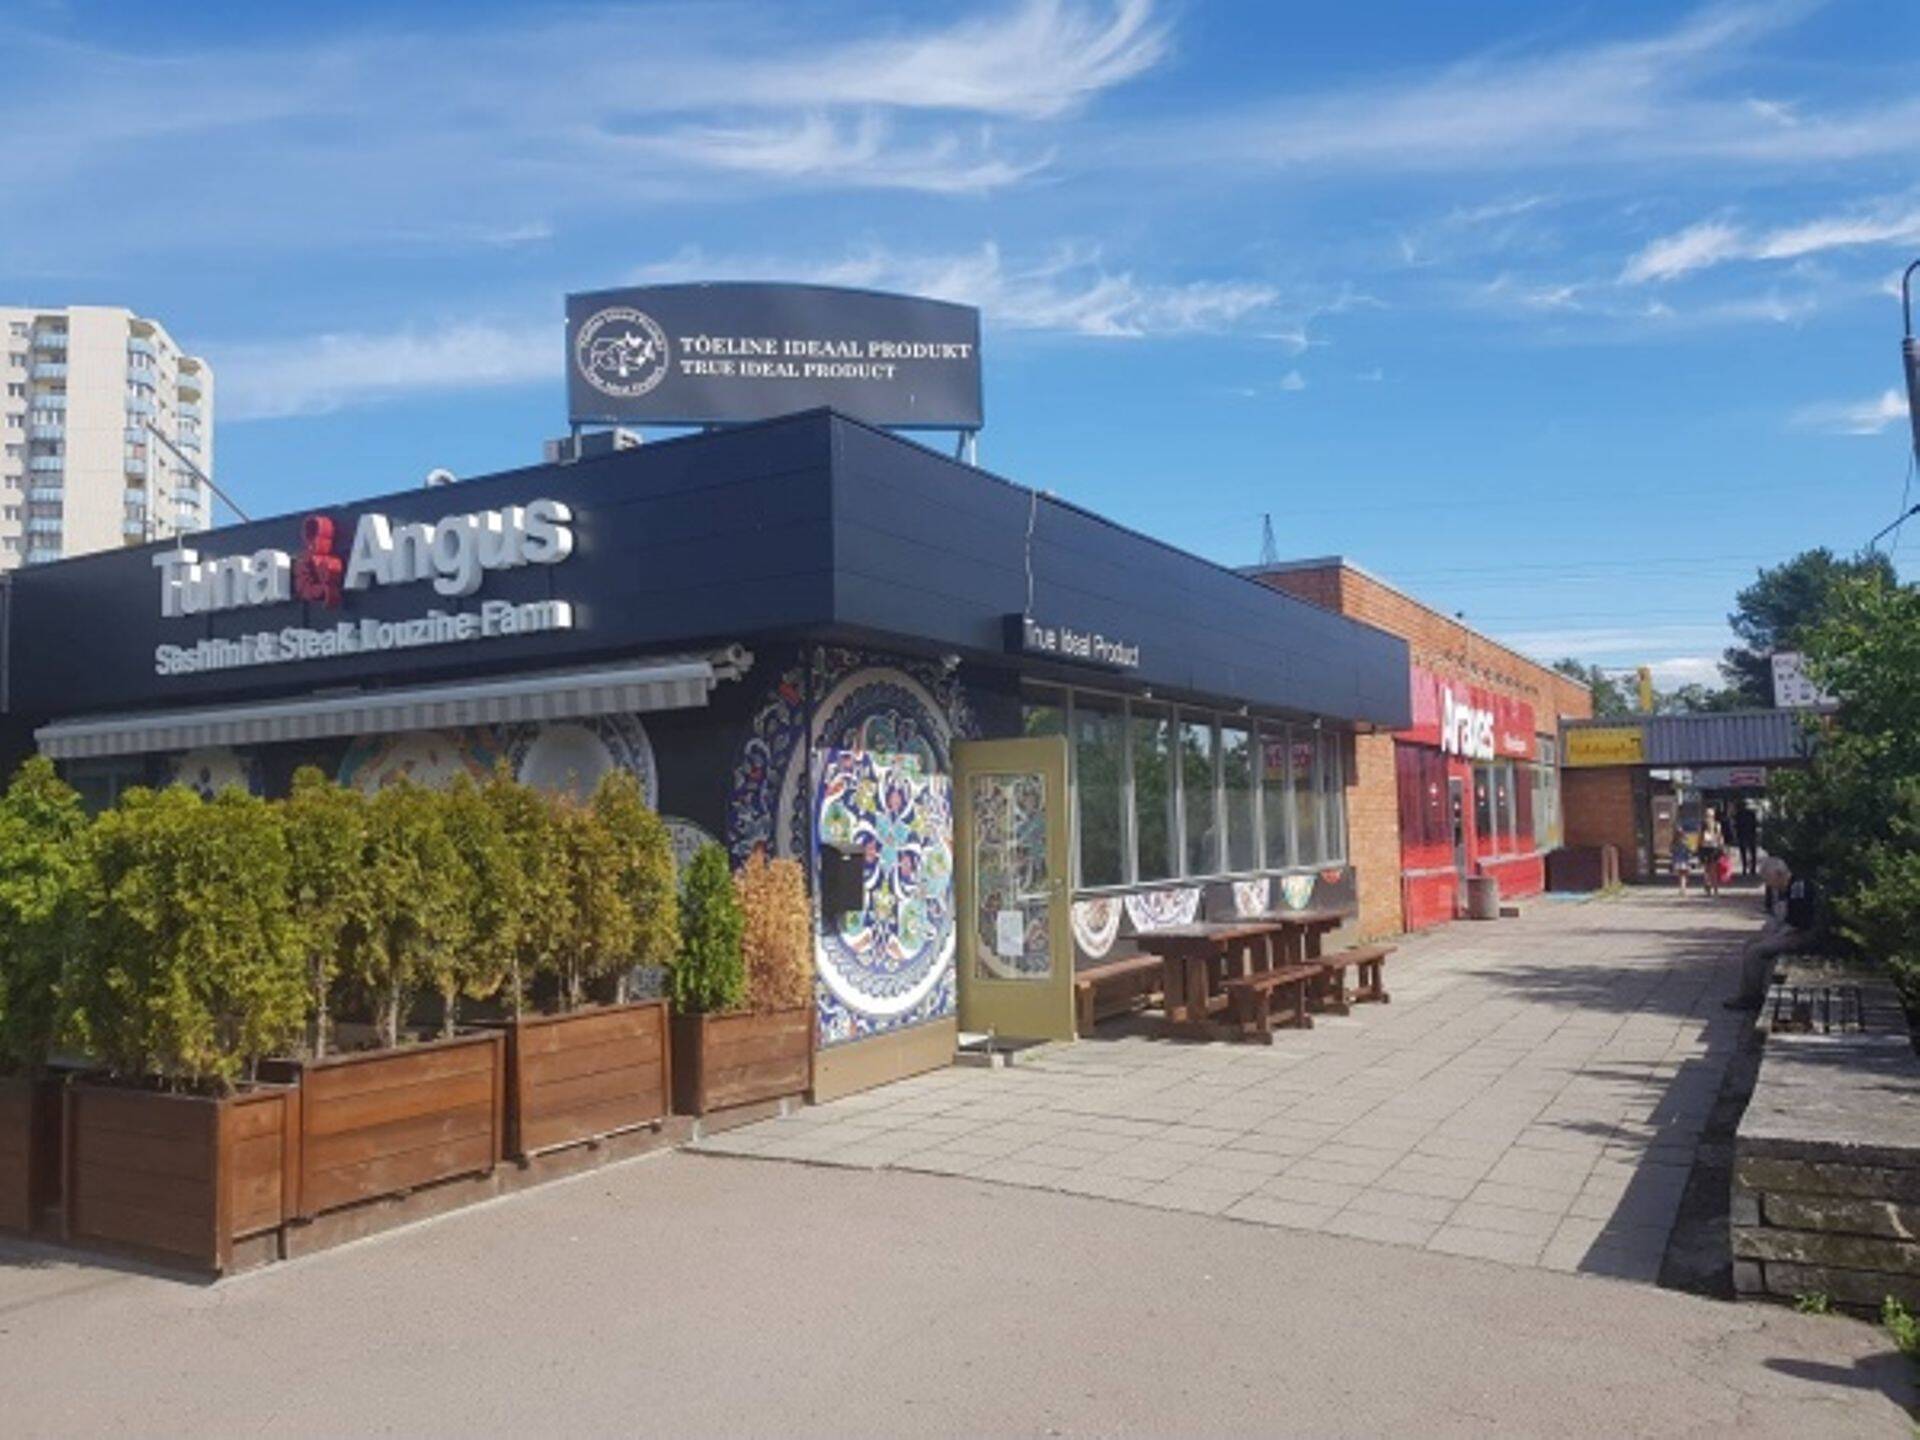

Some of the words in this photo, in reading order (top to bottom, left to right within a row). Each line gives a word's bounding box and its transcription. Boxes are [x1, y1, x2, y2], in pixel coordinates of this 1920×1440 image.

[680, 359, 735, 375] TRUE
[740, 361, 799, 378] IDEAL
[804, 363, 896, 379] PRODUCT
[784, 339, 863, 358] IDEAAL
[868, 341, 972, 359] PRODUKT
[153, 548, 291, 617] Tuna
[344, 499, 573, 597] Angus
[280, 622, 360, 660] Steak
[482, 600, 573, 637] Farm
